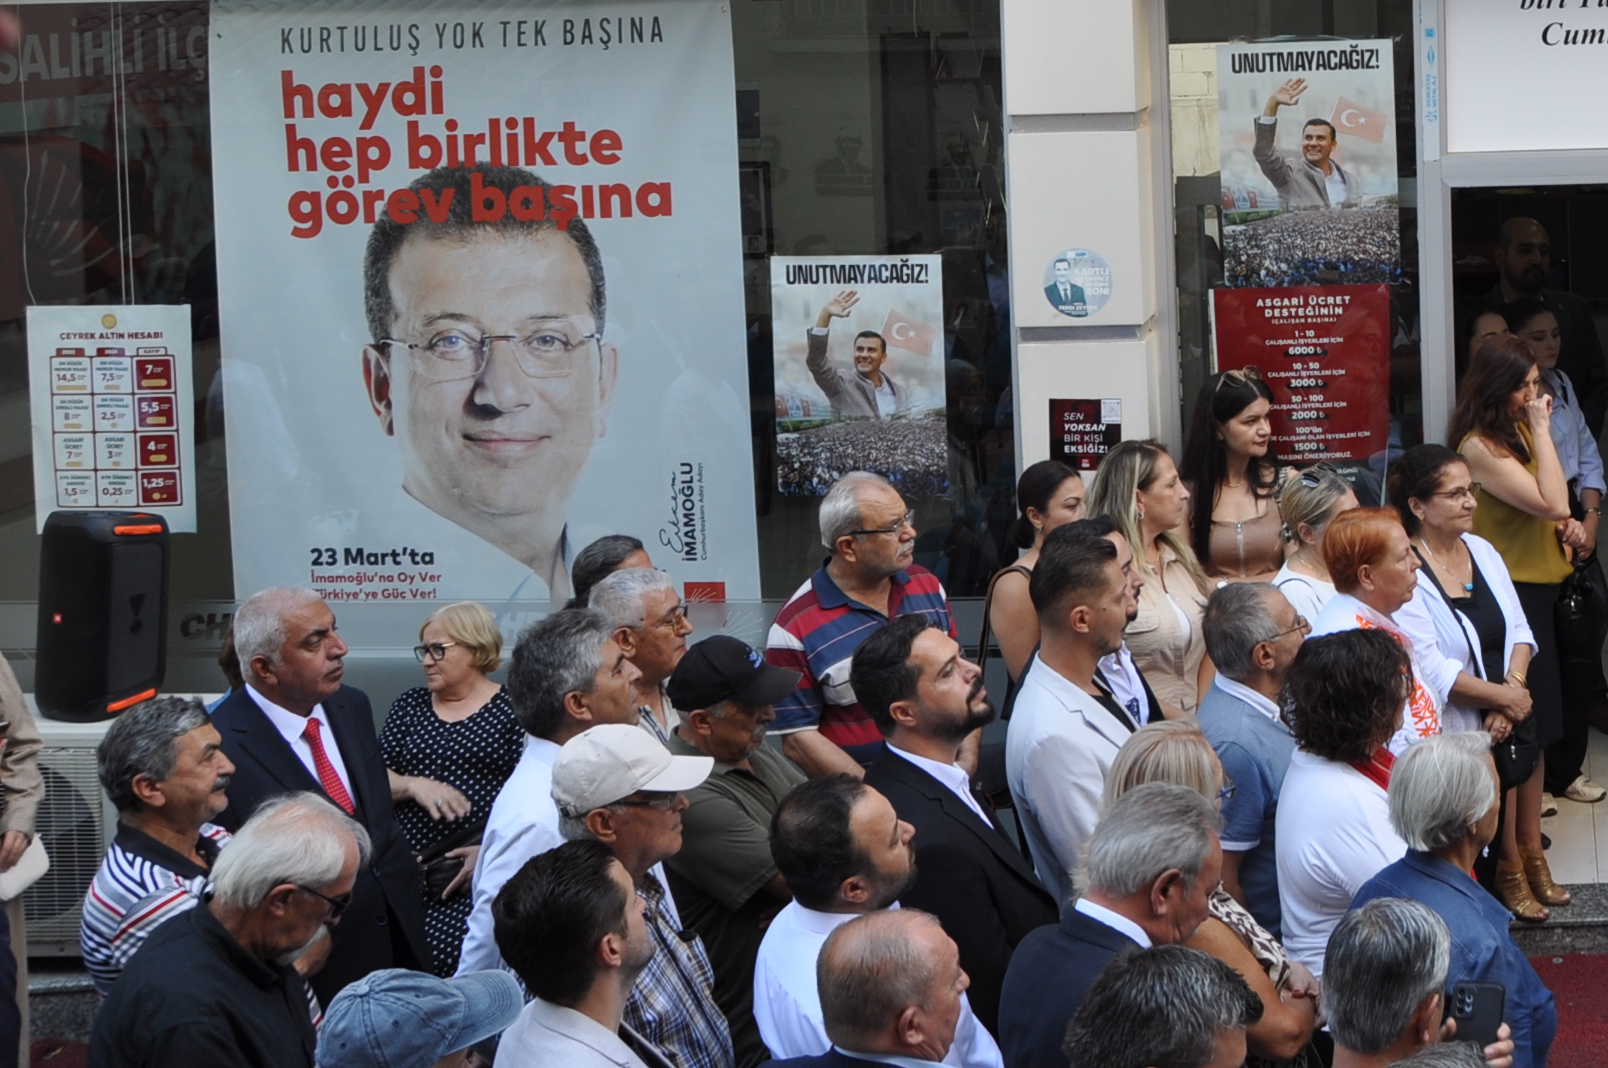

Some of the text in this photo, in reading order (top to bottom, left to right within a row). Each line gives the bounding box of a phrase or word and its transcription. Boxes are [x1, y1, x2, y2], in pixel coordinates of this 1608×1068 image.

[281, 16, 664, 56] KURTULUŞ YOK TEK BAŞINA
[157, 14, 210, 81] İLÇ
[1230, 42, 1379, 75] UNUTMAYACAĞIZ!
[280, 66, 444, 130] haydi
[285, 118, 623, 184] hep birlikte
[287, 176, 673, 239] görev başına
[785, 258, 929, 286] UNUTMAYACAĞIZ!
[1256, 295, 1351, 307] ASGARİ ÜCRET
[1264, 306, 1343, 318] DESTEĞİNİN
[60, 331, 163, 340] ÇEYREK ALTIN HESABI
[1288, 346, 1314, 355] 6000
[1293, 362, 1302, 370] 10
[56, 364, 153, 382] 14,5 7,5 7
[1290, 379, 1315, 387] 3000
[1309, 394, 1324, 402] 100
[101, 412, 116, 421] 2,5
[140, 402, 160, 413] 5,5
[1063, 413, 1084, 421] SEN
[1291, 411, 1317, 419] 2000
[1064, 423, 1106, 432] YOKSAN
[1064, 433, 1103, 444] BİR KİŞİ
[147, 441, 156, 451] 4
[1064, 444, 1108, 454] EKSİĞİZ!
[1294, 442, 1317, 450] 1500
[66, 451, 113, 459] 7 3
[143, 478, 164, 488] 1,25
[64, 487, 123, 497] 1,5 0,25
[679, 462, 698, 561] İMAMOĞLU
[310, 546, 434, 566] 23 Mart'ta
[310, 569, 441, 585] İmamoğlu'na Oy Ver
[409, 588, 436, 599] Ver!
[180, 613, 235, 639] CH
